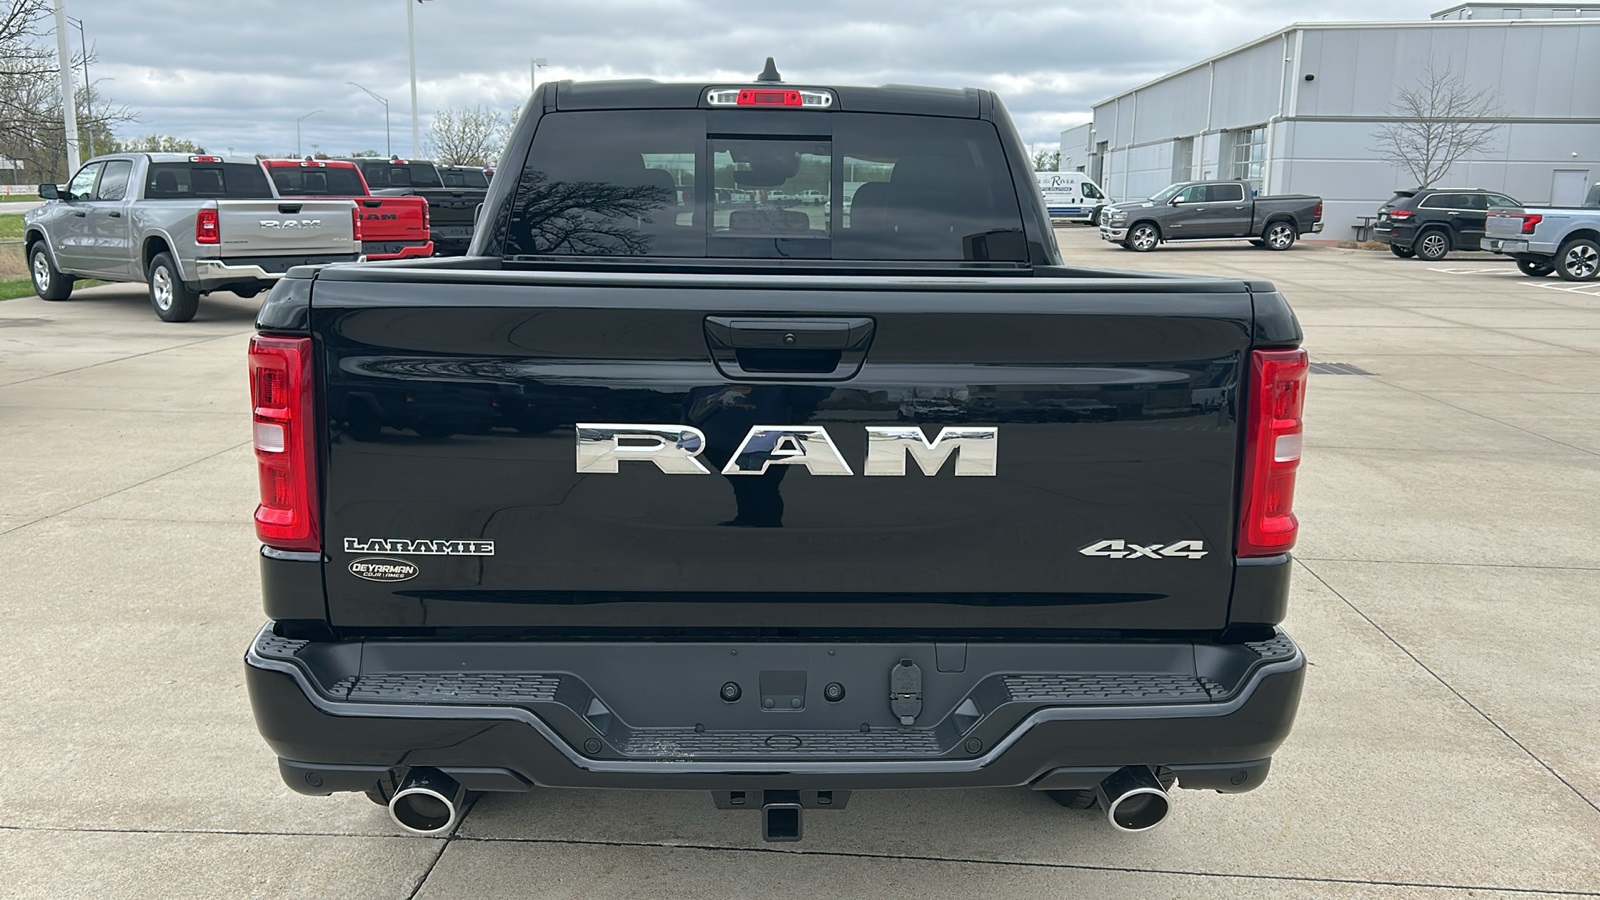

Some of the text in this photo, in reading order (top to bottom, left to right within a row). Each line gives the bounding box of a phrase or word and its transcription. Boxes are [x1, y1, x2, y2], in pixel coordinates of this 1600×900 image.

[1051, 175, 1074, 187] RIVER
[259, 219, 321, 229] RAM
[576, 423, 999, 476] RAM
[344, 538, 494, 555] LARAMIE
[1078, 539, 1209, 559] 4x4
[352, 563, 414, 574] DEYARMAN
